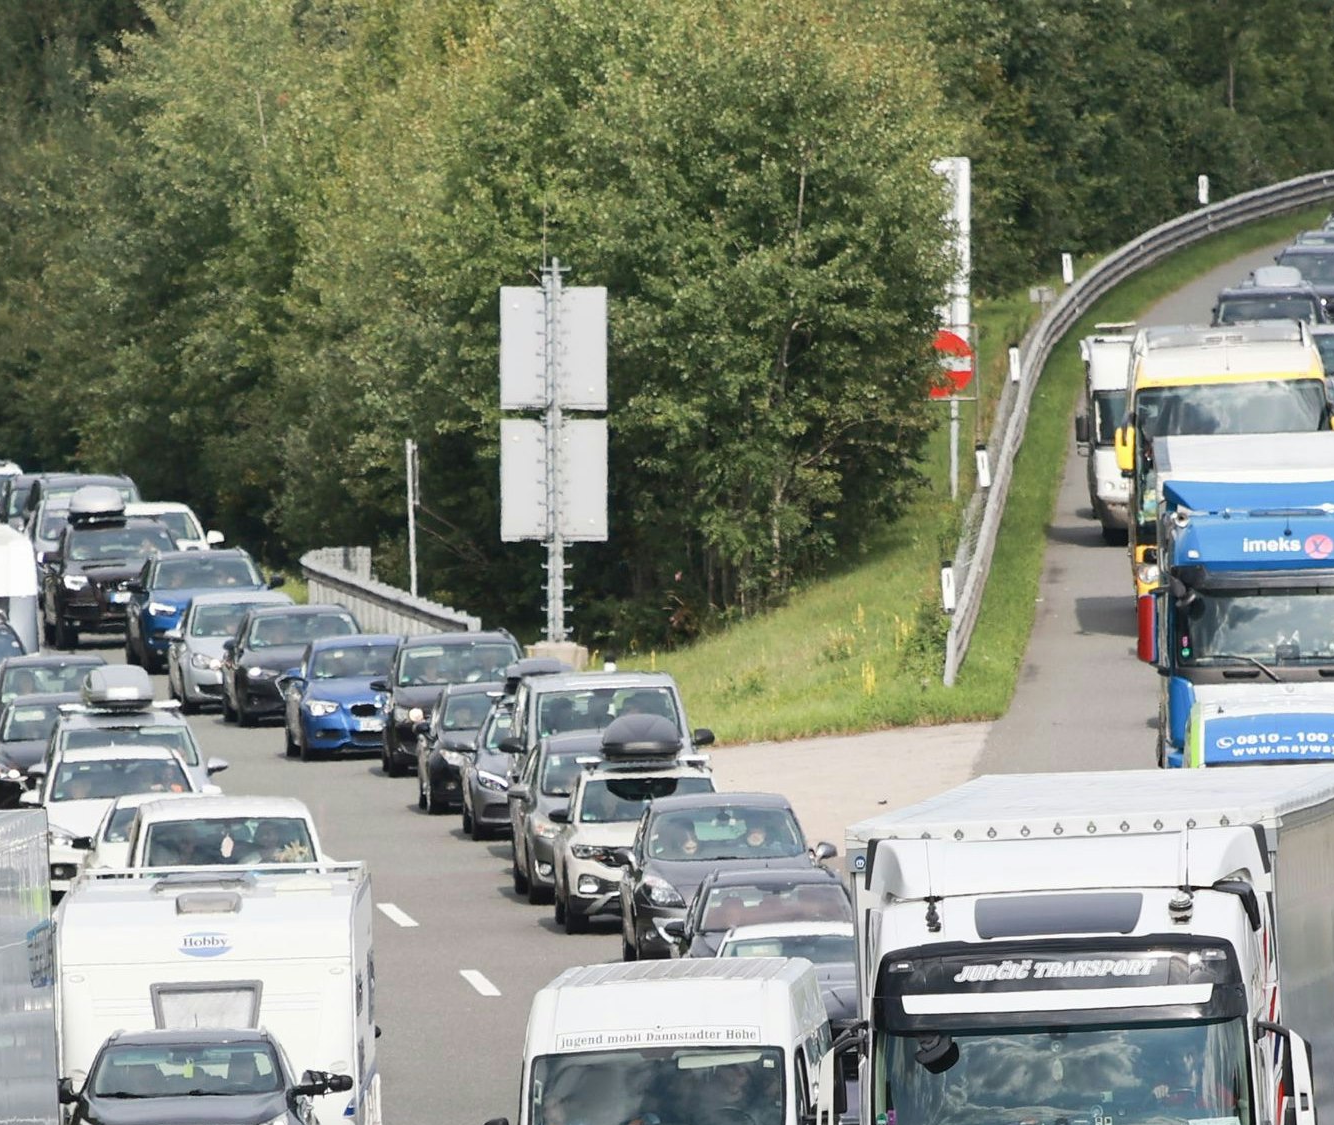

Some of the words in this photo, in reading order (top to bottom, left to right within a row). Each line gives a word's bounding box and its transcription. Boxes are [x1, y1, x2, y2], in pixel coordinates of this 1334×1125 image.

[1242, 536, 1302, 553] imeks
[1236, 733, 1280, 745] 0810
[1296, 732, 1329, 743] 100
[183, 936, 228, 948] Hobby
[1033, 959, 1158, 979] TRANSPORT
[560, 1034, 603, 1049] jugend
[607, 1032, 642, 1045] mobil
[646, 1028, 721, 1042] Dannstadter
[726, 1027, 757, 1040] Höhe
